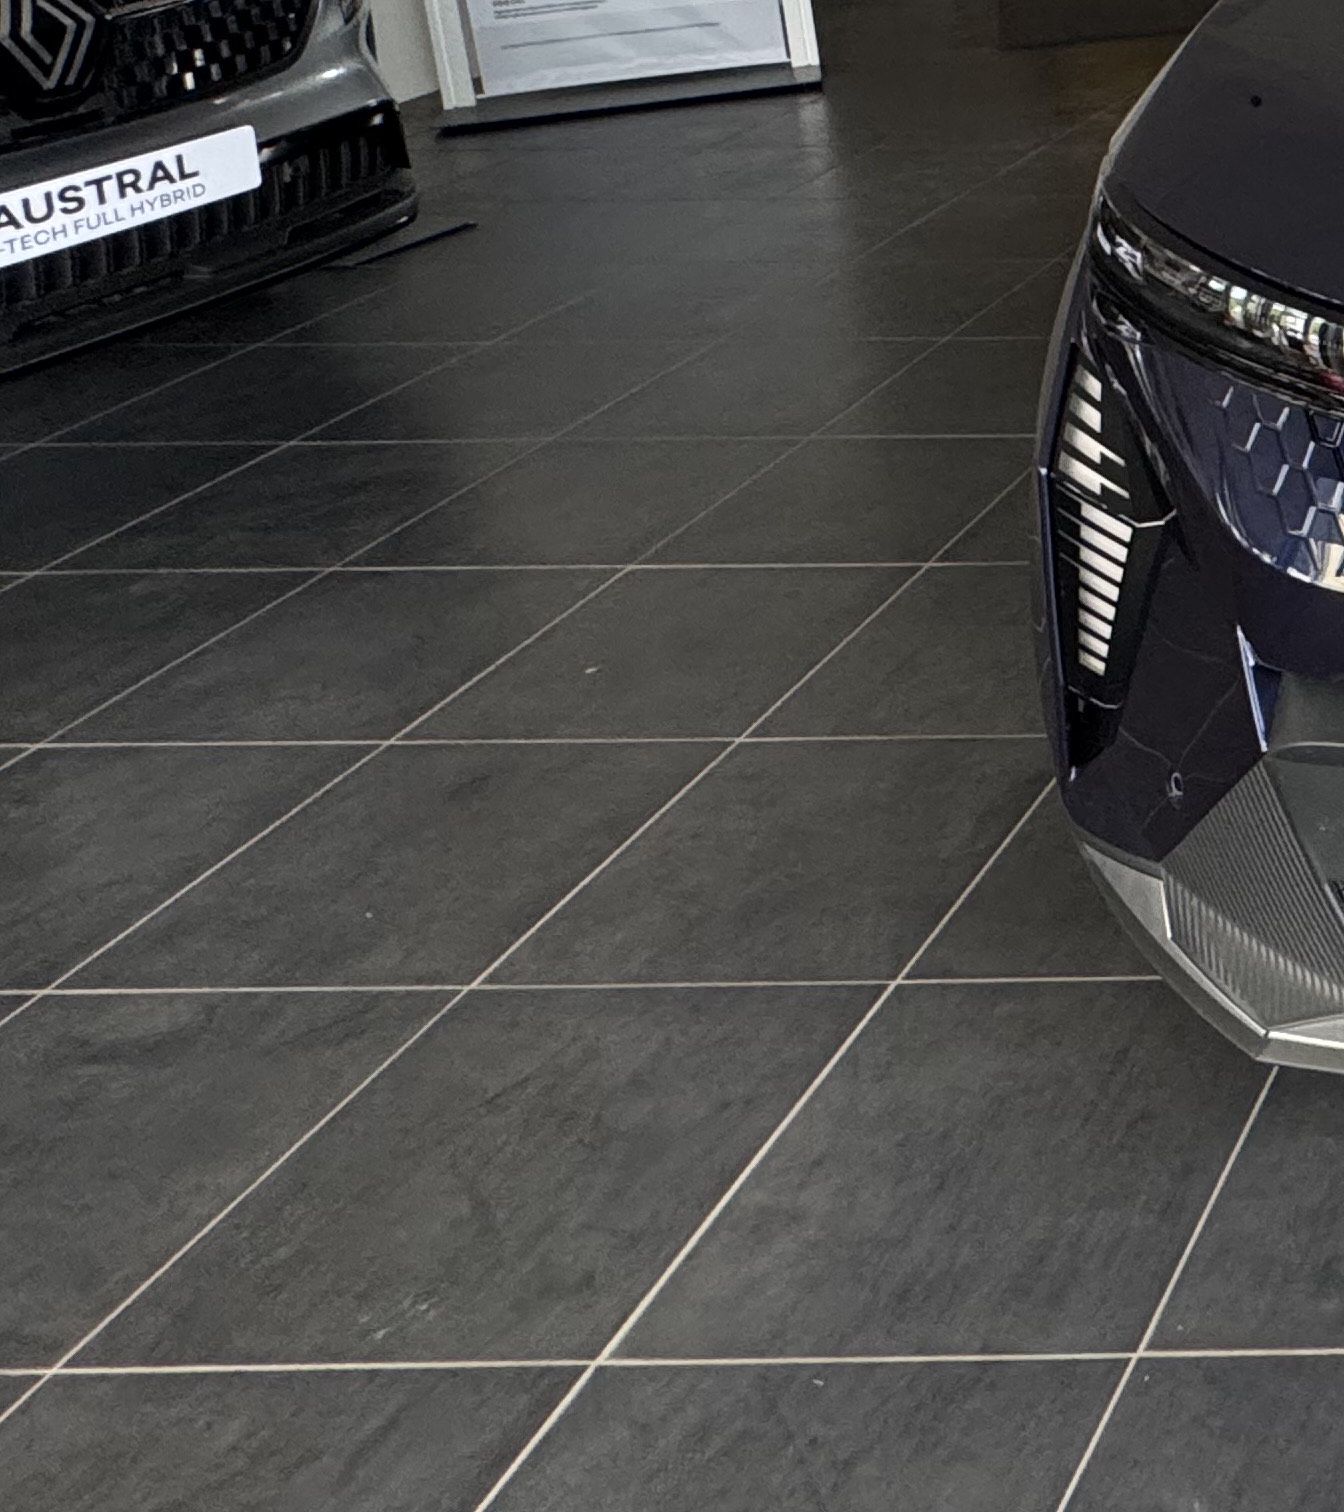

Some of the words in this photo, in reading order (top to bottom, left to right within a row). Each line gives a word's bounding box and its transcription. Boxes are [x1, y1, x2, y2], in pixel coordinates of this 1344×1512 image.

[0, 154, 200, 230] AUSTRAL
[73, 209, 127, 234] FULL
[130, 182, 206, 218] HYBRID
